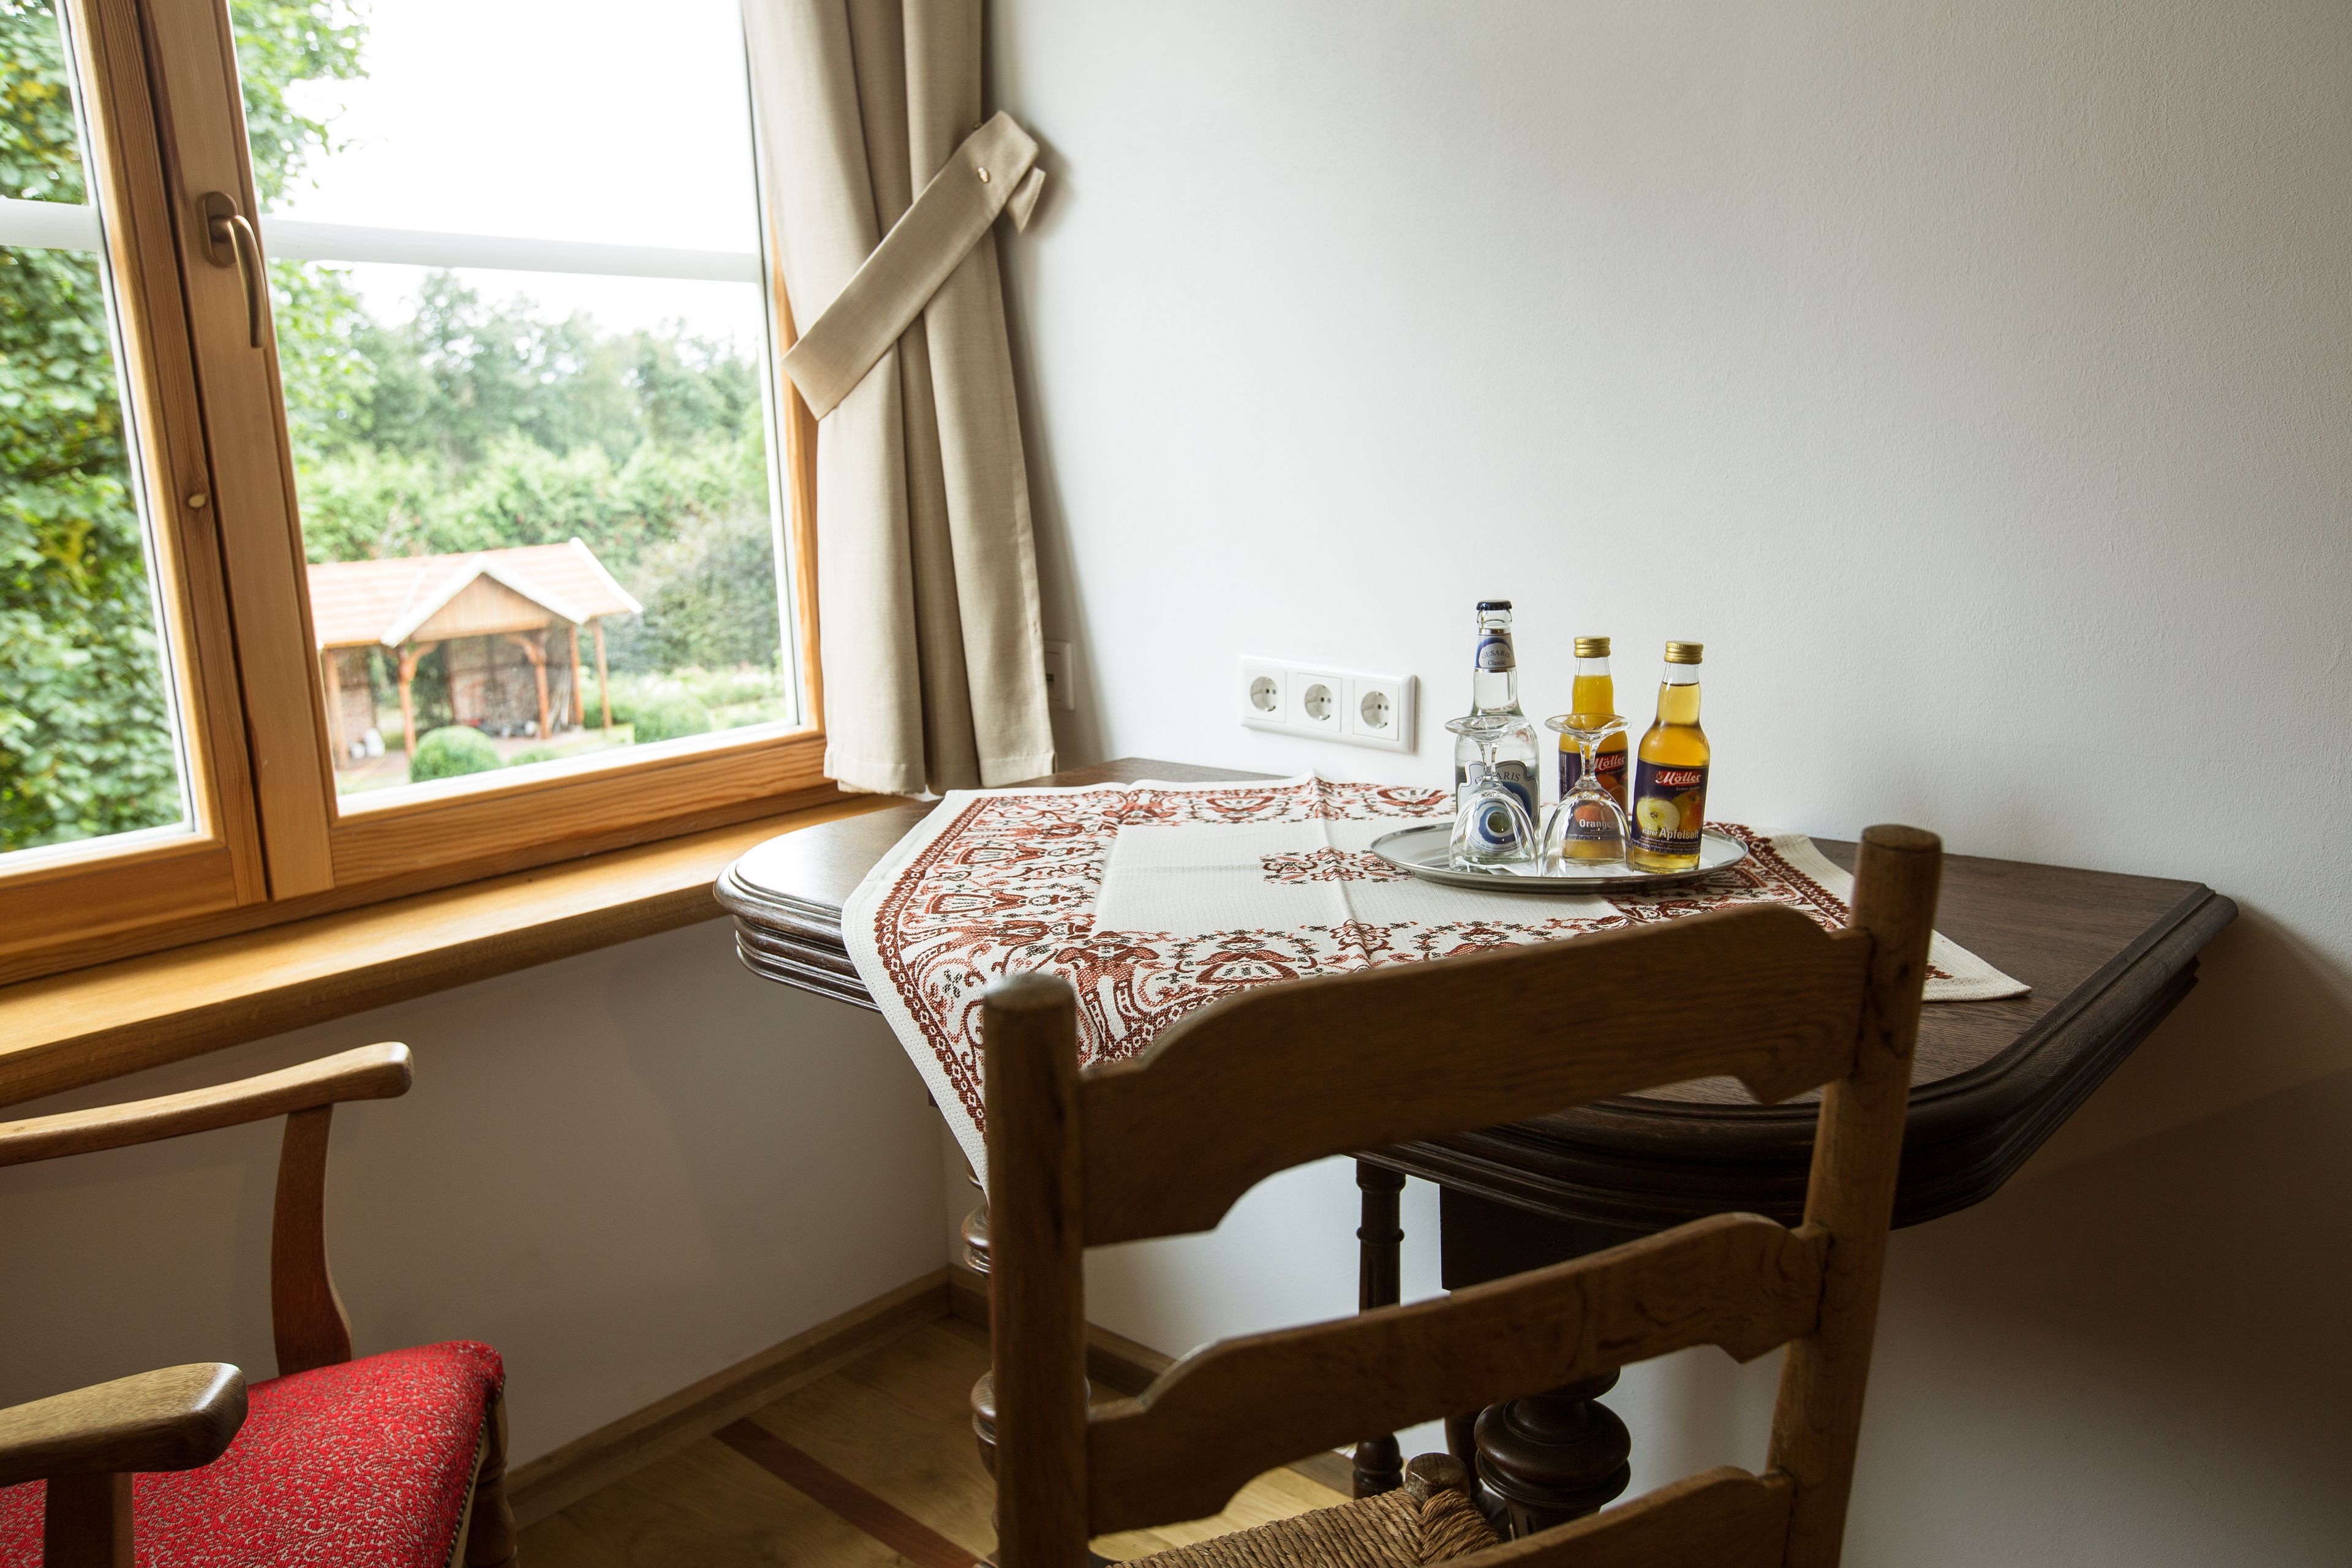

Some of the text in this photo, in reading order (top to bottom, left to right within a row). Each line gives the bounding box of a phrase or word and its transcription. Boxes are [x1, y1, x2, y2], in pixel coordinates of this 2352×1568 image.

[1481, 650, 1511, 659] GESARIS
[1475, 771, 1520, 785] GARIS
[1655, 771, 1701, 785] Möller
[1642, 826, 1700, 840] klarer Apfelsaft
